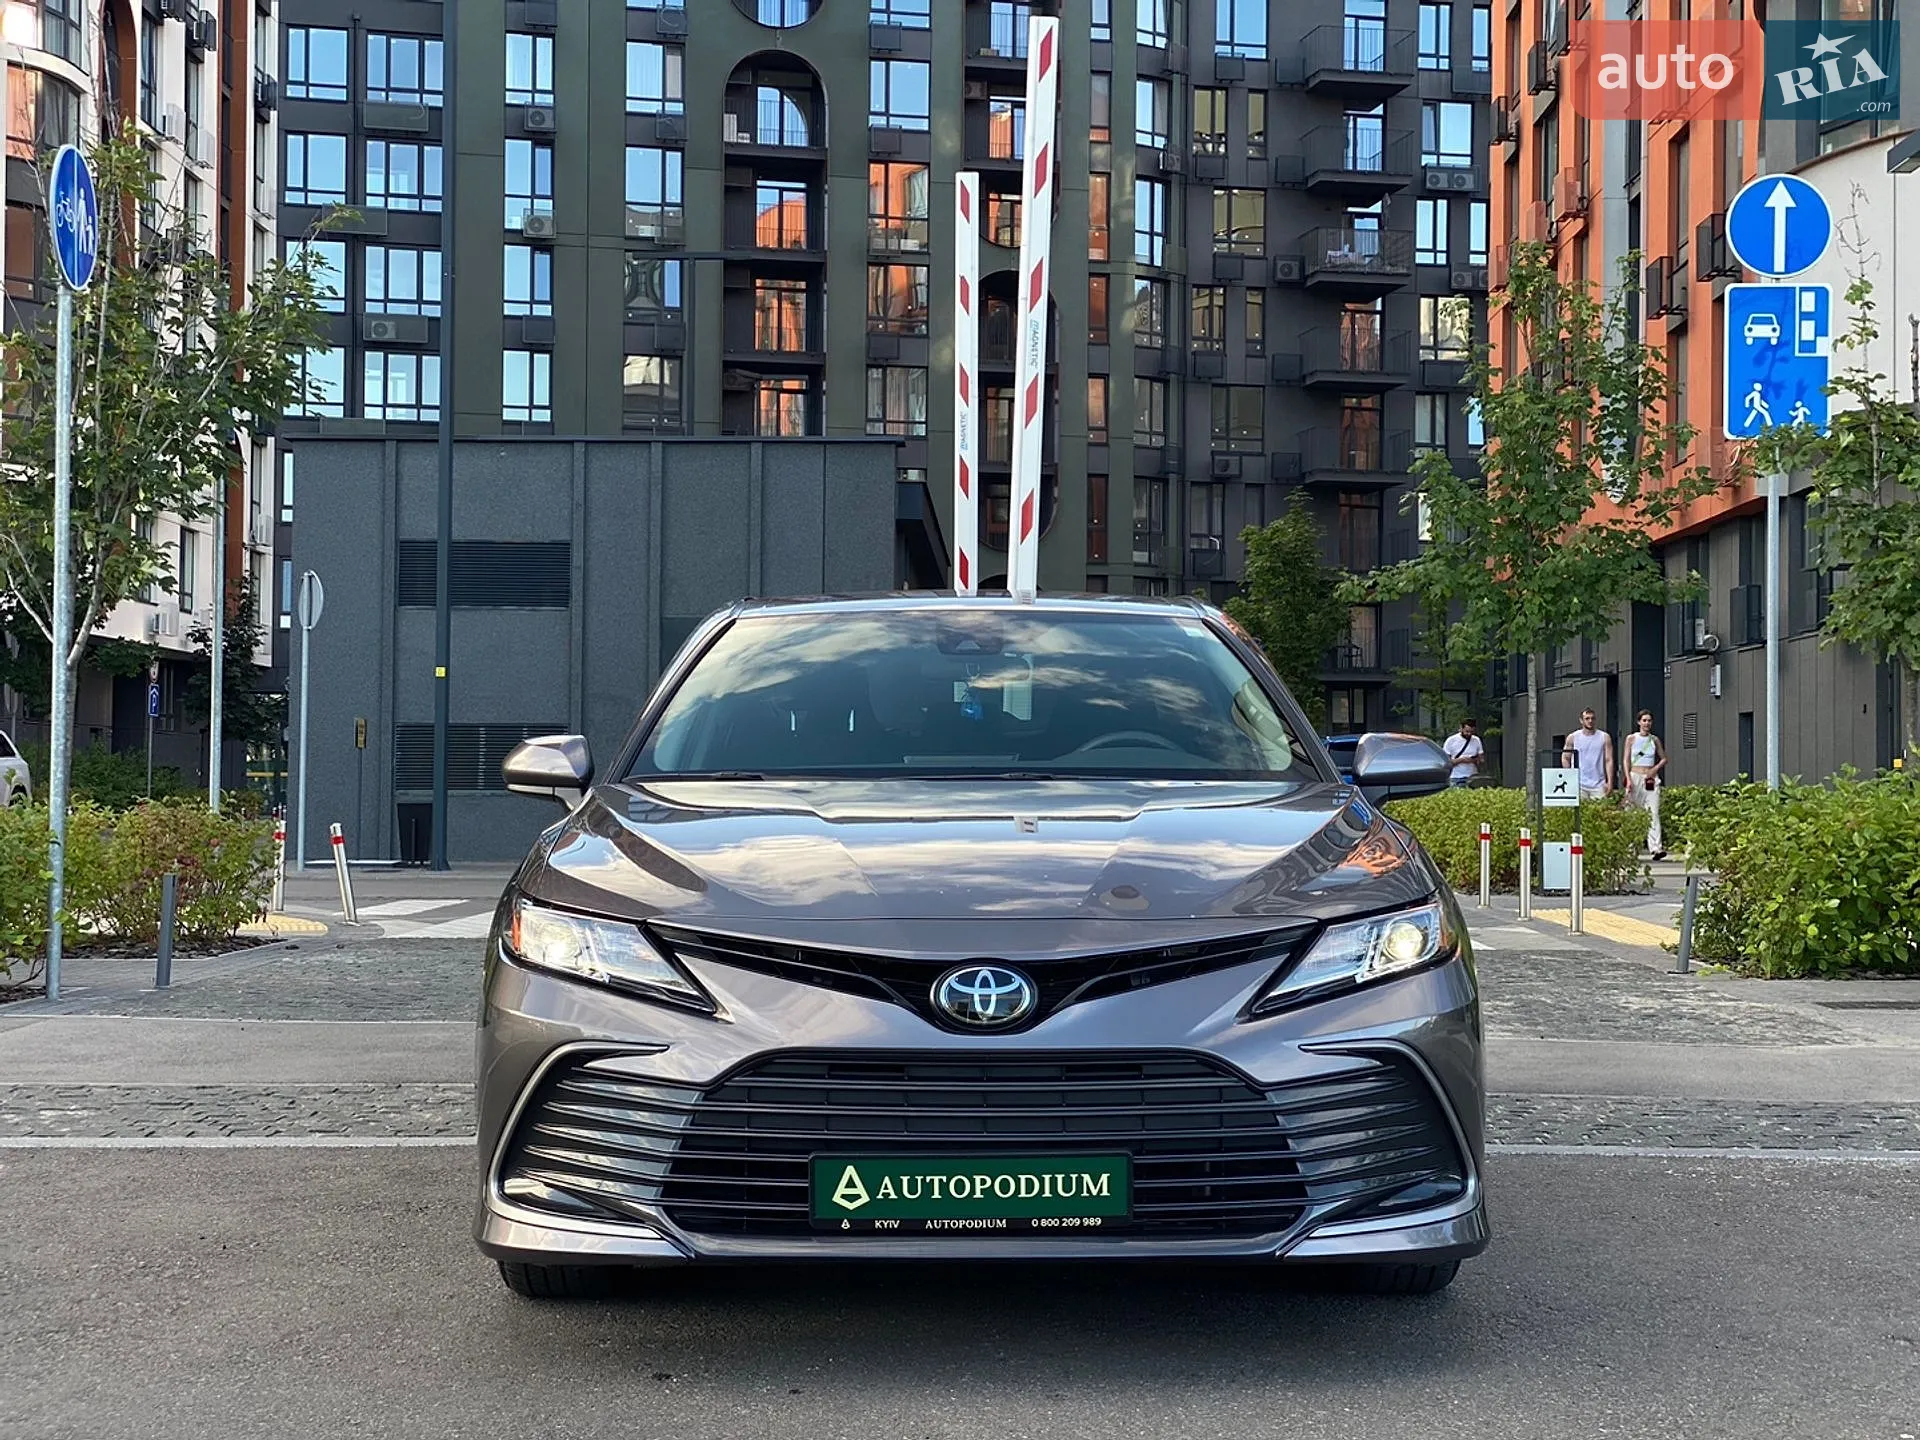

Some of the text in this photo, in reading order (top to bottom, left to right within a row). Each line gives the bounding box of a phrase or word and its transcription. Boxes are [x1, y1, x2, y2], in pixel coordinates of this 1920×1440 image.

[876, 1173, 1111, 1199] AUTOPODIUM
[874, 1219, 900, 1229] KYIV
[925, 1218, 1007, 1229] AUTOPODIUM
[1040, 1218, 1060, 1227] 800
[1061, 1217, 1081, 1227] 209
[1082, 1217, 1102, 1226] 989
